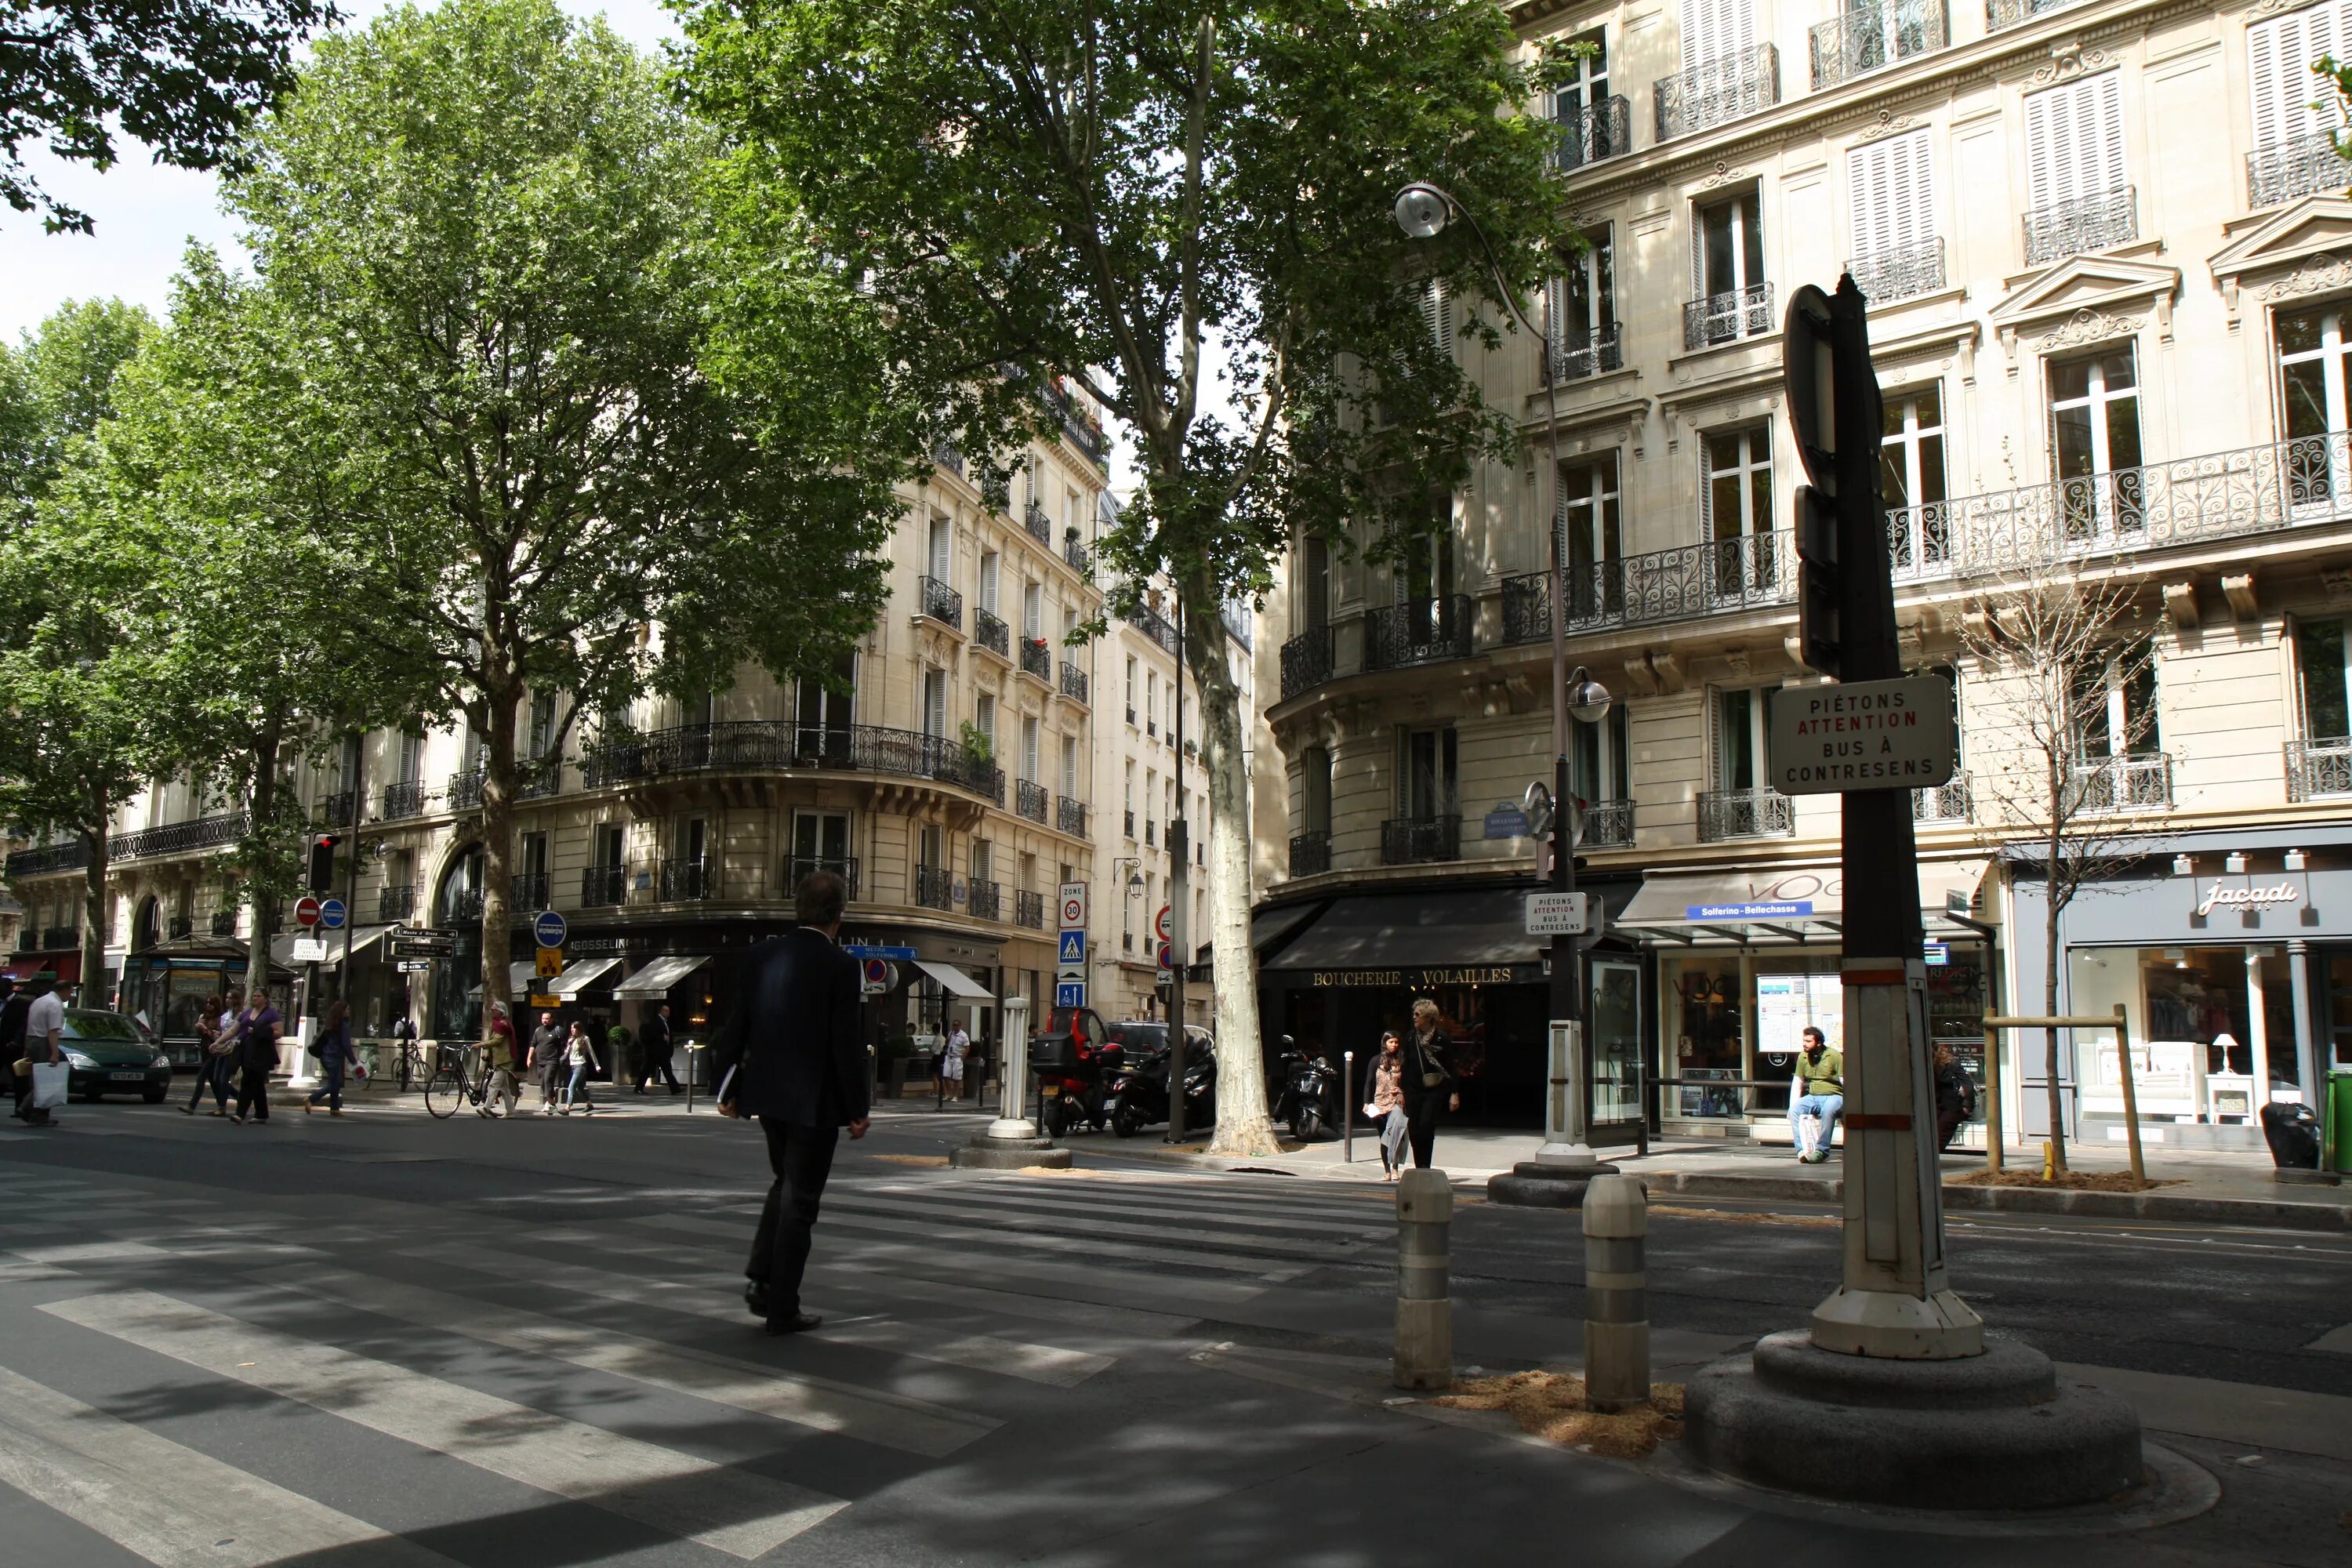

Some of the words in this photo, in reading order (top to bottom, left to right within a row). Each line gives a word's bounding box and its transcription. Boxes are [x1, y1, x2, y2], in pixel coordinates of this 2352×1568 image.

[1810, 692, 1904, 714] PIÉTONS
[1798, 711, 1916, 735] ATTENTION
[1824, 741, 1864, 757] BUS
[1882, 736, 1892, 754] À
[1787, 759, 1933, 782] CONTRESENS
[2198, 878, 2299, 916] jacadi
[1068, 906, 1077, 915] 30
[575, 938, 626, 951] GOSSELIN
[1313, 971, 1401, 986] BOUCHERIE
[1422, 968, 1512, 985] VOLAILLES
